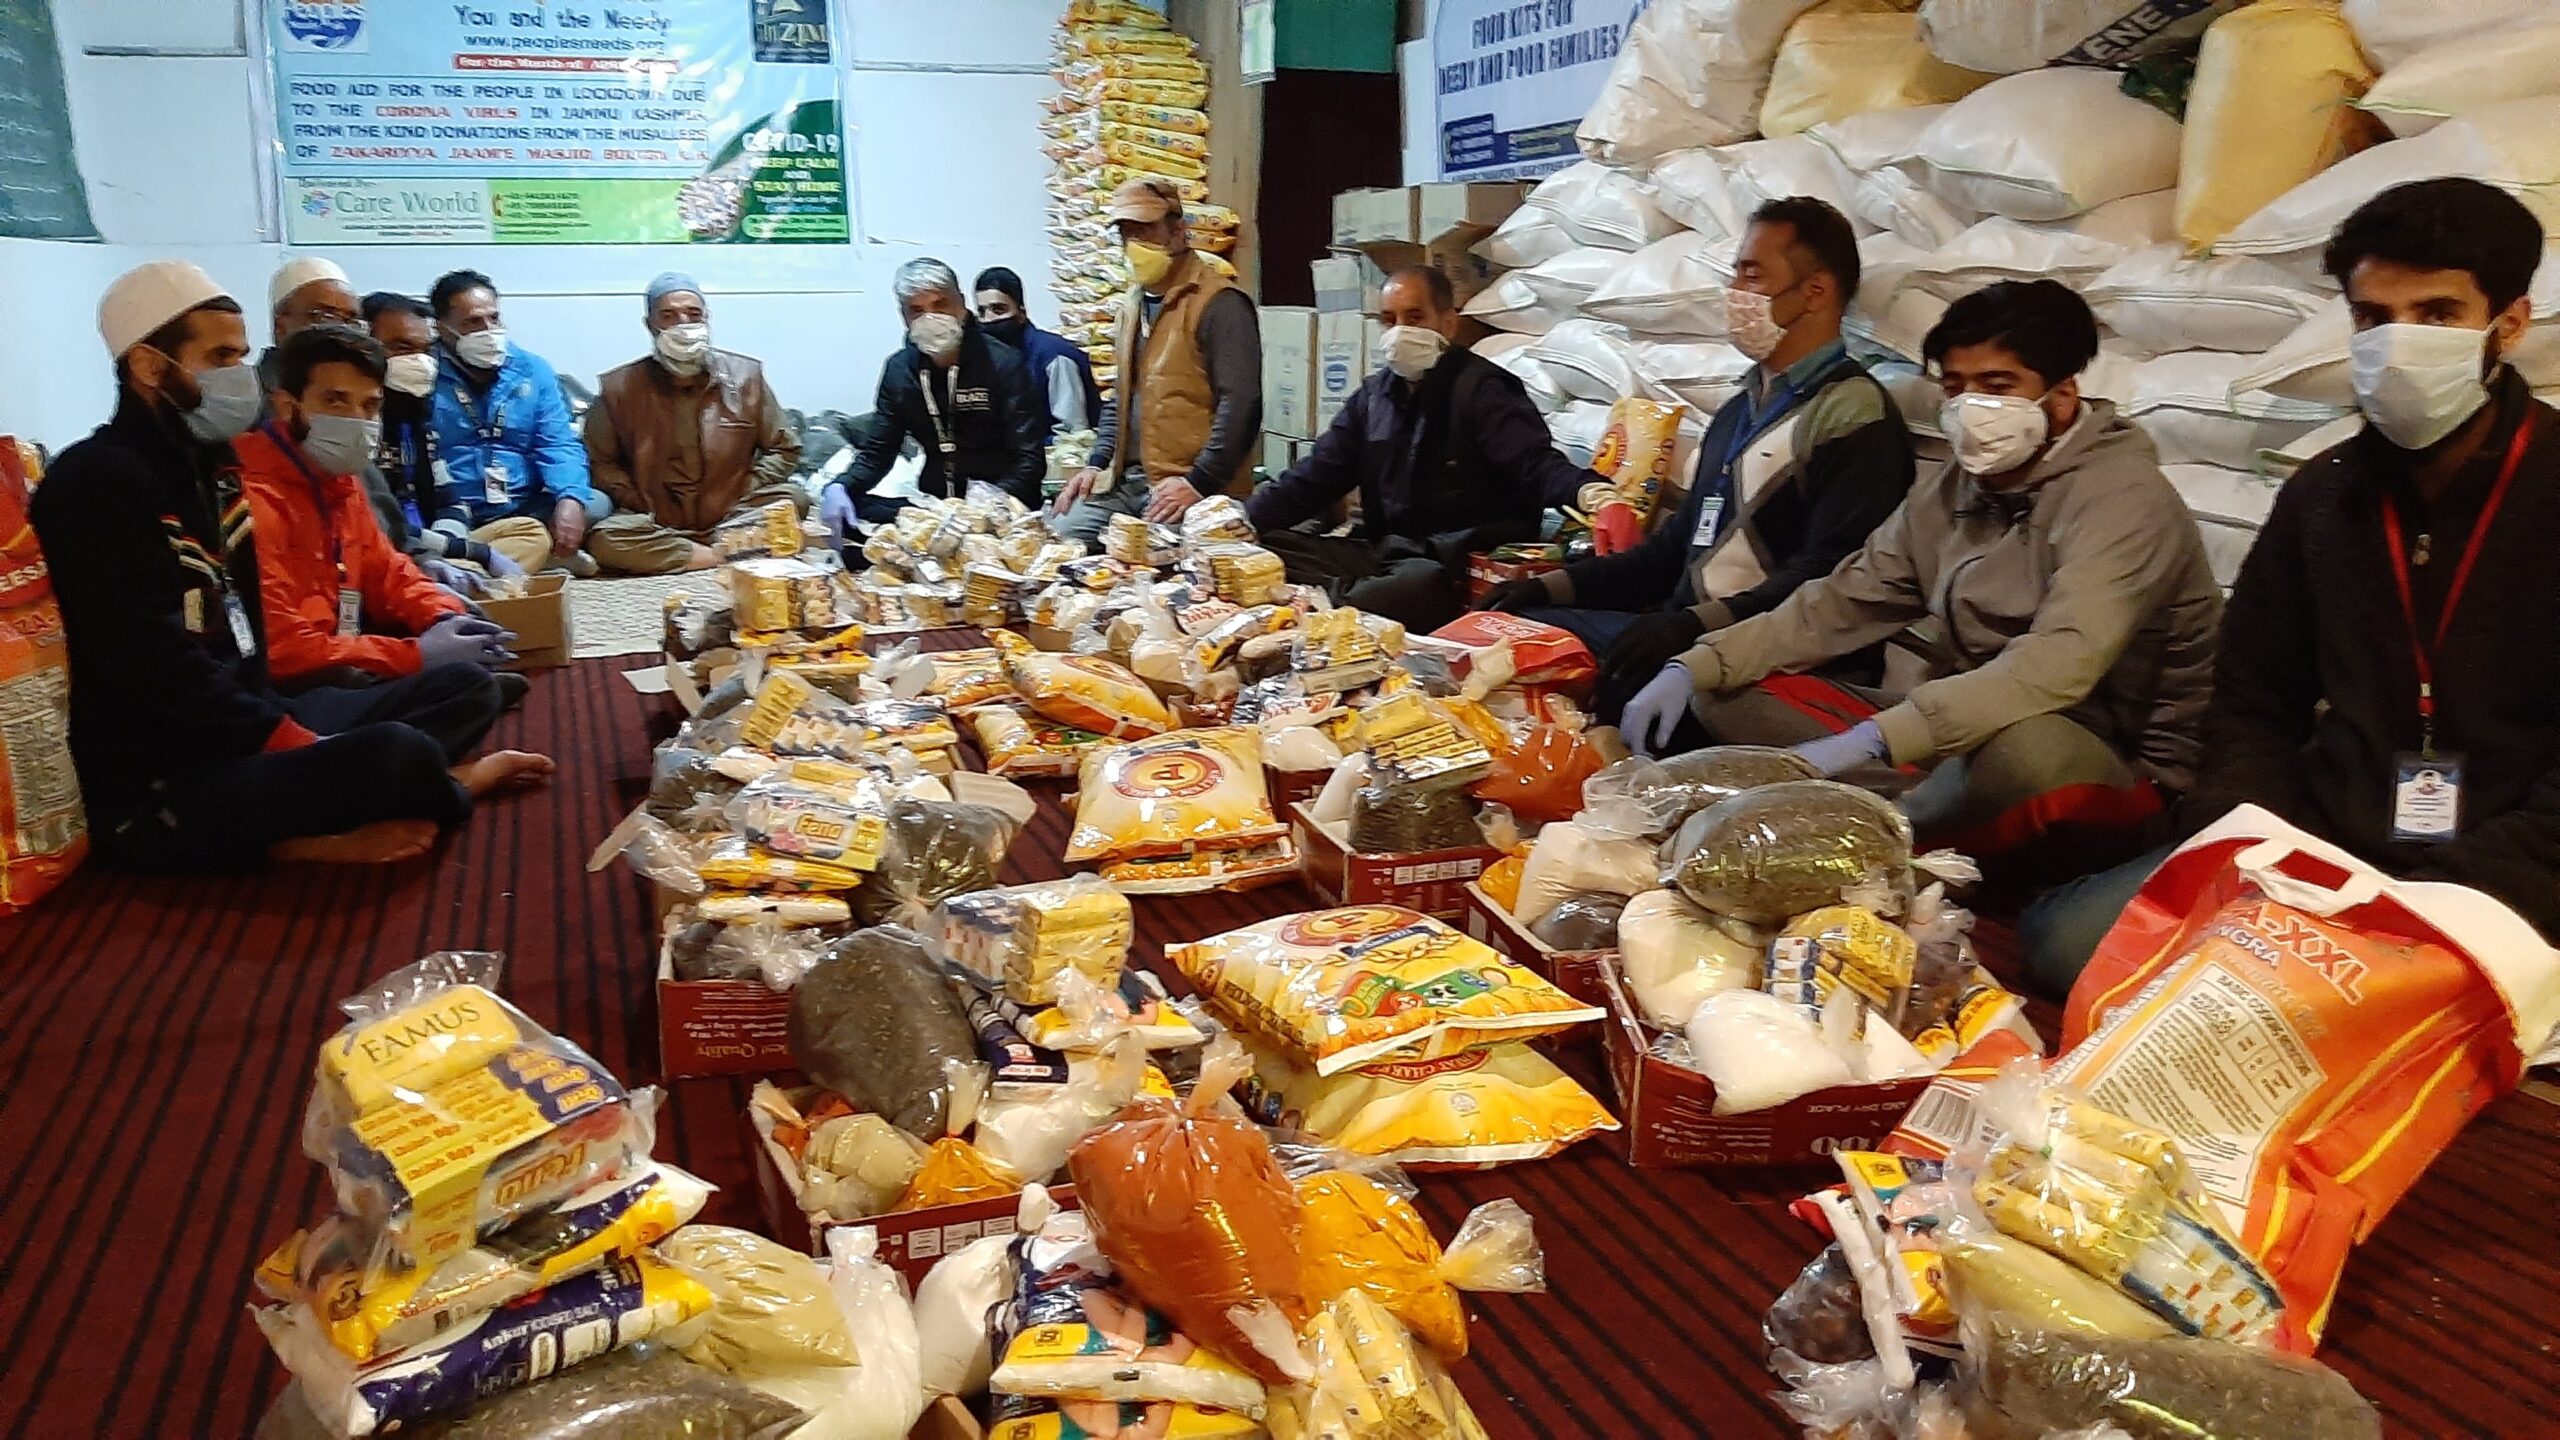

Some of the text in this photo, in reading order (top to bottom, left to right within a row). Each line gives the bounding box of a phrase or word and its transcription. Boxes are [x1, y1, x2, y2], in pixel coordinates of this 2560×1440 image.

[453, 4, 671, 36] You and the Needy
[291, 83, 336, 96] FOOD
[349, 84, 379, 97] AID
[389, 84, 424, 97] FOR
[431, 85, 467, 97] THE
[472, 85, 535, 99] PEOPLE
[544, 87, 564, 99] IN
[672, 89, 706, 101] DUE
[291, 104, 317, 117] TO
[326, 104, 363, 117] THE
[375, 105, 452, 118] CORONA
[463, 106, 519, 119] VIRUS
[530, 107, 551, 119] IN
[562, 107, 621, 120] JAMMU
[293, 124, 342, 137] FROM
[346, 125, 380, 137] THE
[384, 125, 427, 138] KIND
[432, 126, 529, 140] DONATIONS
[534, 127, 580, 140] FROM
[583, 128, 617, 140] THE
[295, 145, 319, 158] OF
[334, 191, 481, 213] Care World
[359, 1001, 482, 1064] FAMUS
